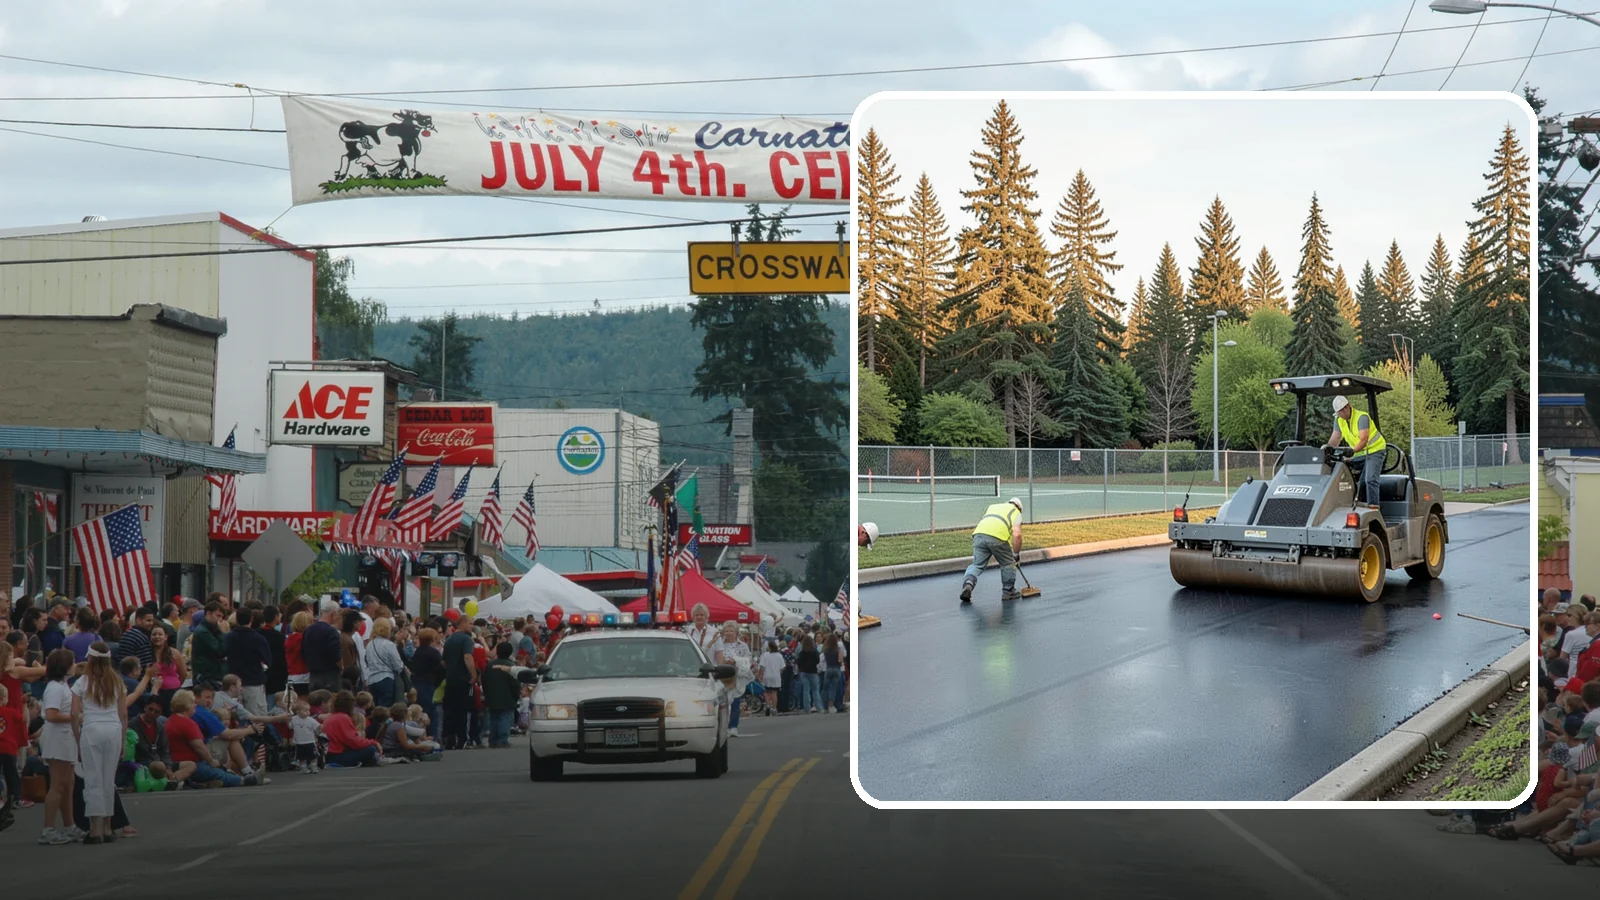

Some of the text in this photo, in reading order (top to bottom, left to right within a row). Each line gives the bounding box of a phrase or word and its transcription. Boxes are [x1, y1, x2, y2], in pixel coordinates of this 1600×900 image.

[695, 121, 850, 149] Carnat
[481, 141, 604, 192] JULY
[632, 150, 746, 198] 4th.
[696, 254, 850, 280] CROSSWA
[282, 379, 374, 420] ACE
[405, 409, 486, 422] CEDAR LOG
[283, 421, 371, 437] Hardware
[416, 428, 477, 447] Coca-Cola
[353, 467, 387, 481] Simpl
[83, 484, 155, 496] St. Vincent de Paul
[688, 526, 741, 535] CRNATION
[699, 535, 730, 543] GLASS
